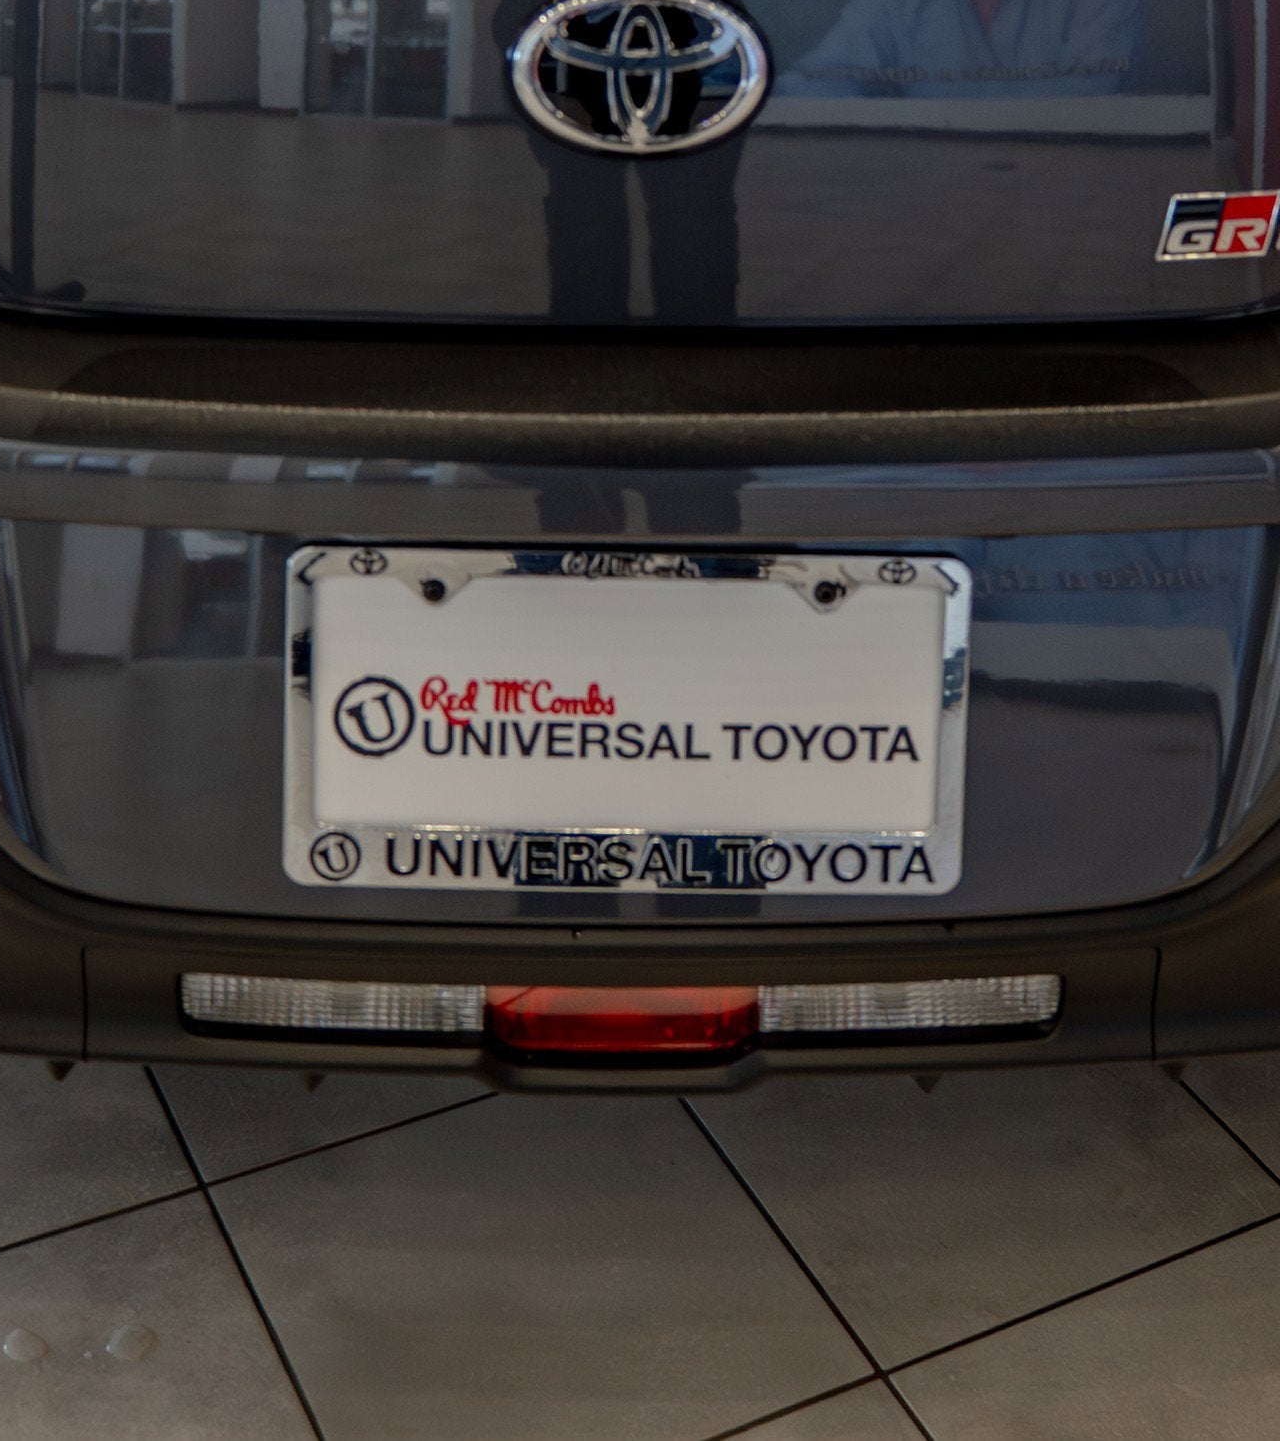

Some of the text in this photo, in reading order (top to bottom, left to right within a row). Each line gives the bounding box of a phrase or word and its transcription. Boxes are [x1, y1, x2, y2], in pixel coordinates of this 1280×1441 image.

[421, 676, 616, 720] Red McCombs
[423, 719, 710, 761] UNIVERSAL
[721, 723, 920, 762] TOYOTA
[385, 832, 936, 885] UNIVERSAL TOYOTA
